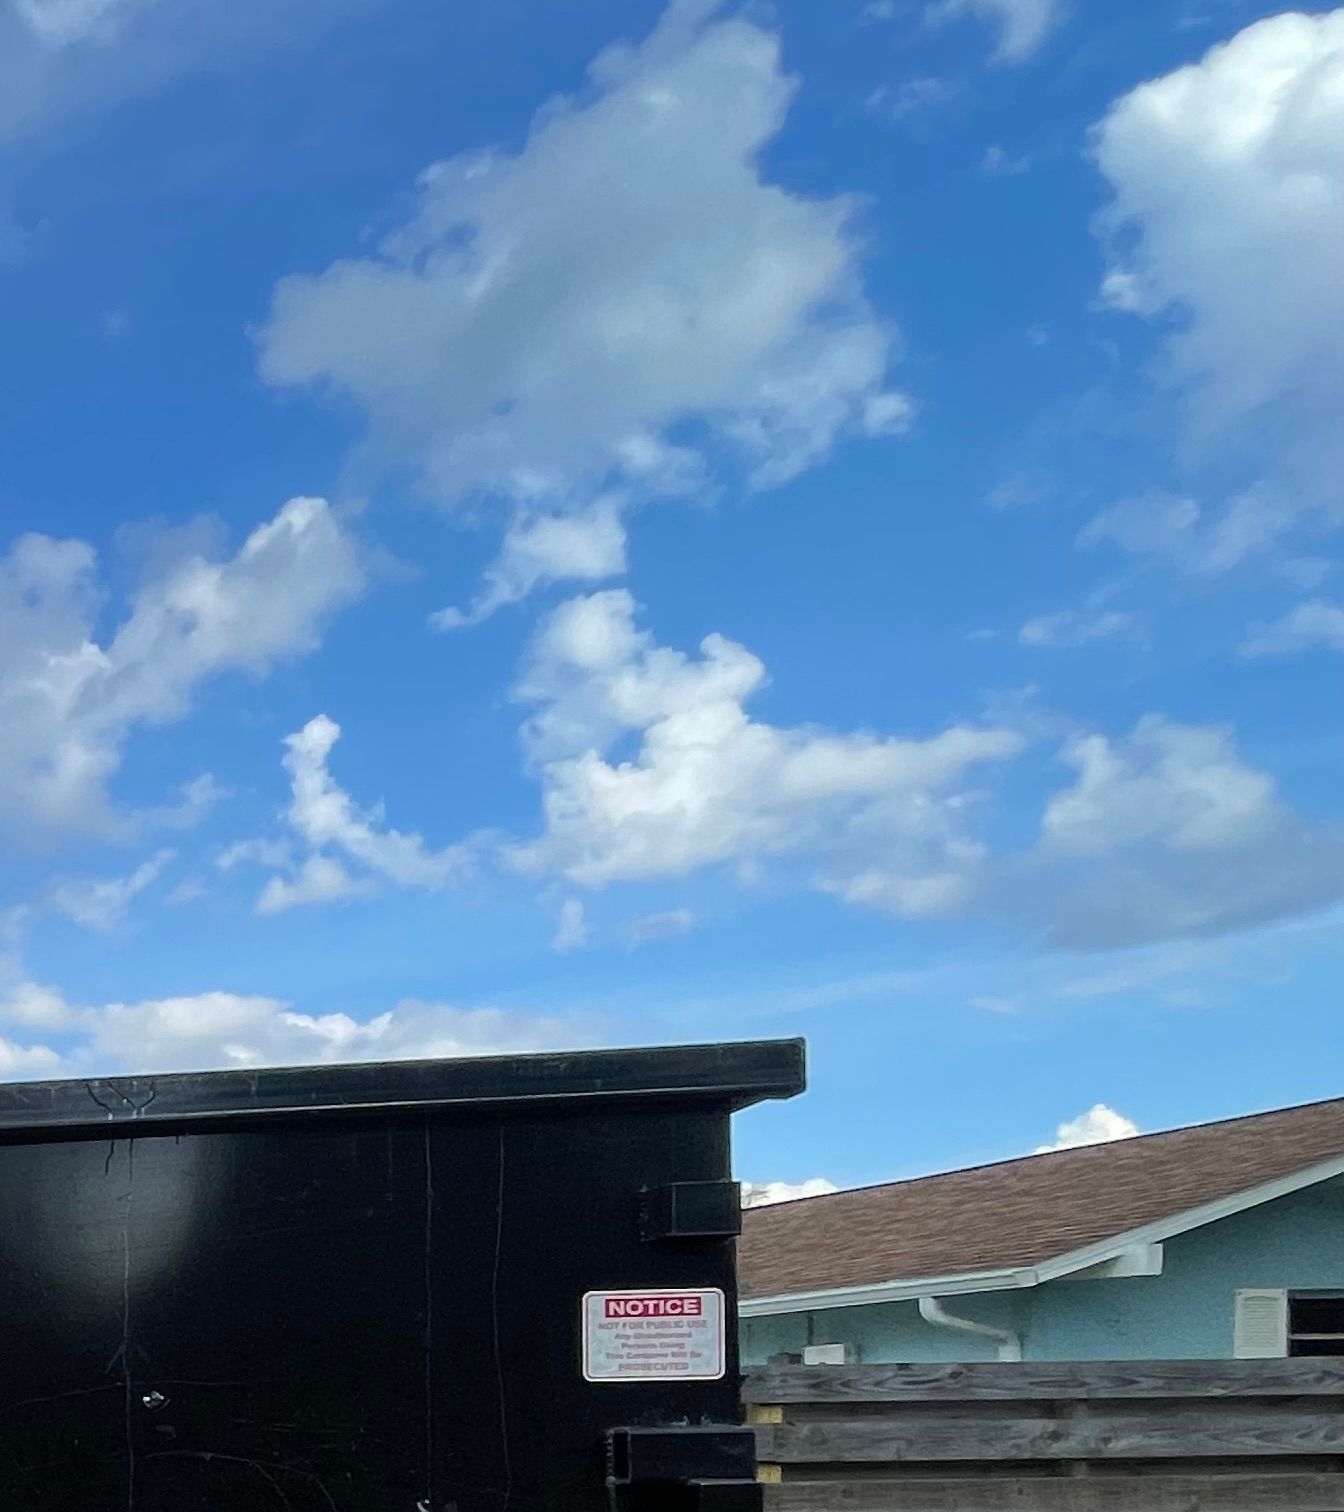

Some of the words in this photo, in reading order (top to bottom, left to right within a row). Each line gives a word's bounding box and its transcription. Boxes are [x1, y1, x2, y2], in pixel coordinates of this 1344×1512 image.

[608, 1299, 699, 1316] NOTICE
[598, 1322, 620, 1330] NOT
[646, 1320, 684, 1329] PUBLIC
[687, 1319, 708, 1328] USE
